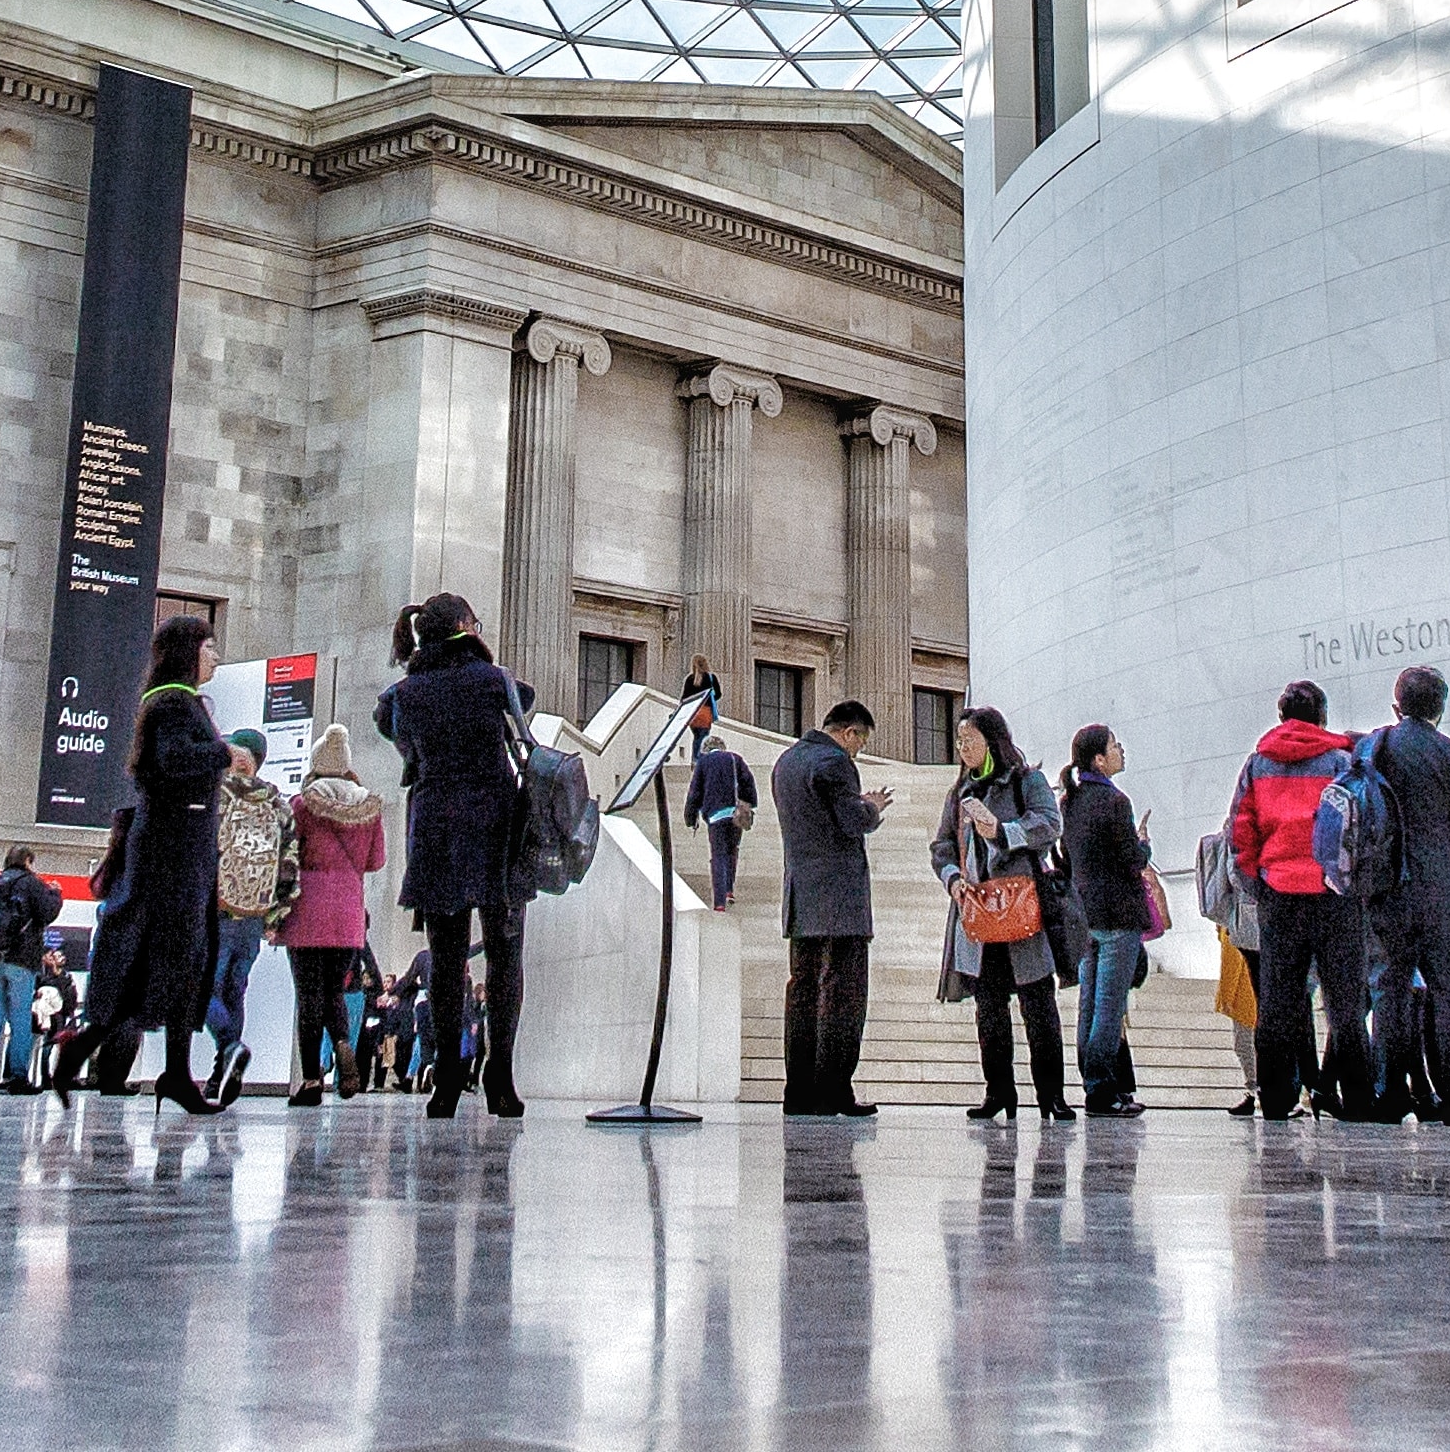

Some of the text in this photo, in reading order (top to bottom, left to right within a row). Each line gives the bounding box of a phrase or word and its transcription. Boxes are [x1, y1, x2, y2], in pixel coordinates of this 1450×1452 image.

[83, 421, 128, 438] Mummies.
[82, 433, 150, 454] Ancient Greece.
[80, 446, 122, 462] Jewellery.
[80, 457, 142, 477] Anglo-Saxons.
[78, 470, 110, 483] African
[78, 481, 109, 496] Money.
[77, 493, 145, 514] Asian porcelain.
[76, 505, 142, 525] Roman Empire.
[75, 517, 119, 533] Sculpture.
[74, 530, 136, 548] Ancient Egypt.
[72, 553, 90, 566] The
[71, 566, 139, 585] British Museum
[70, 579, 110, 595] your way
[1299, 632, 1342, 670] The
[58, 707, 108, 730] Audio
[56, 733, 105, 754] guide
